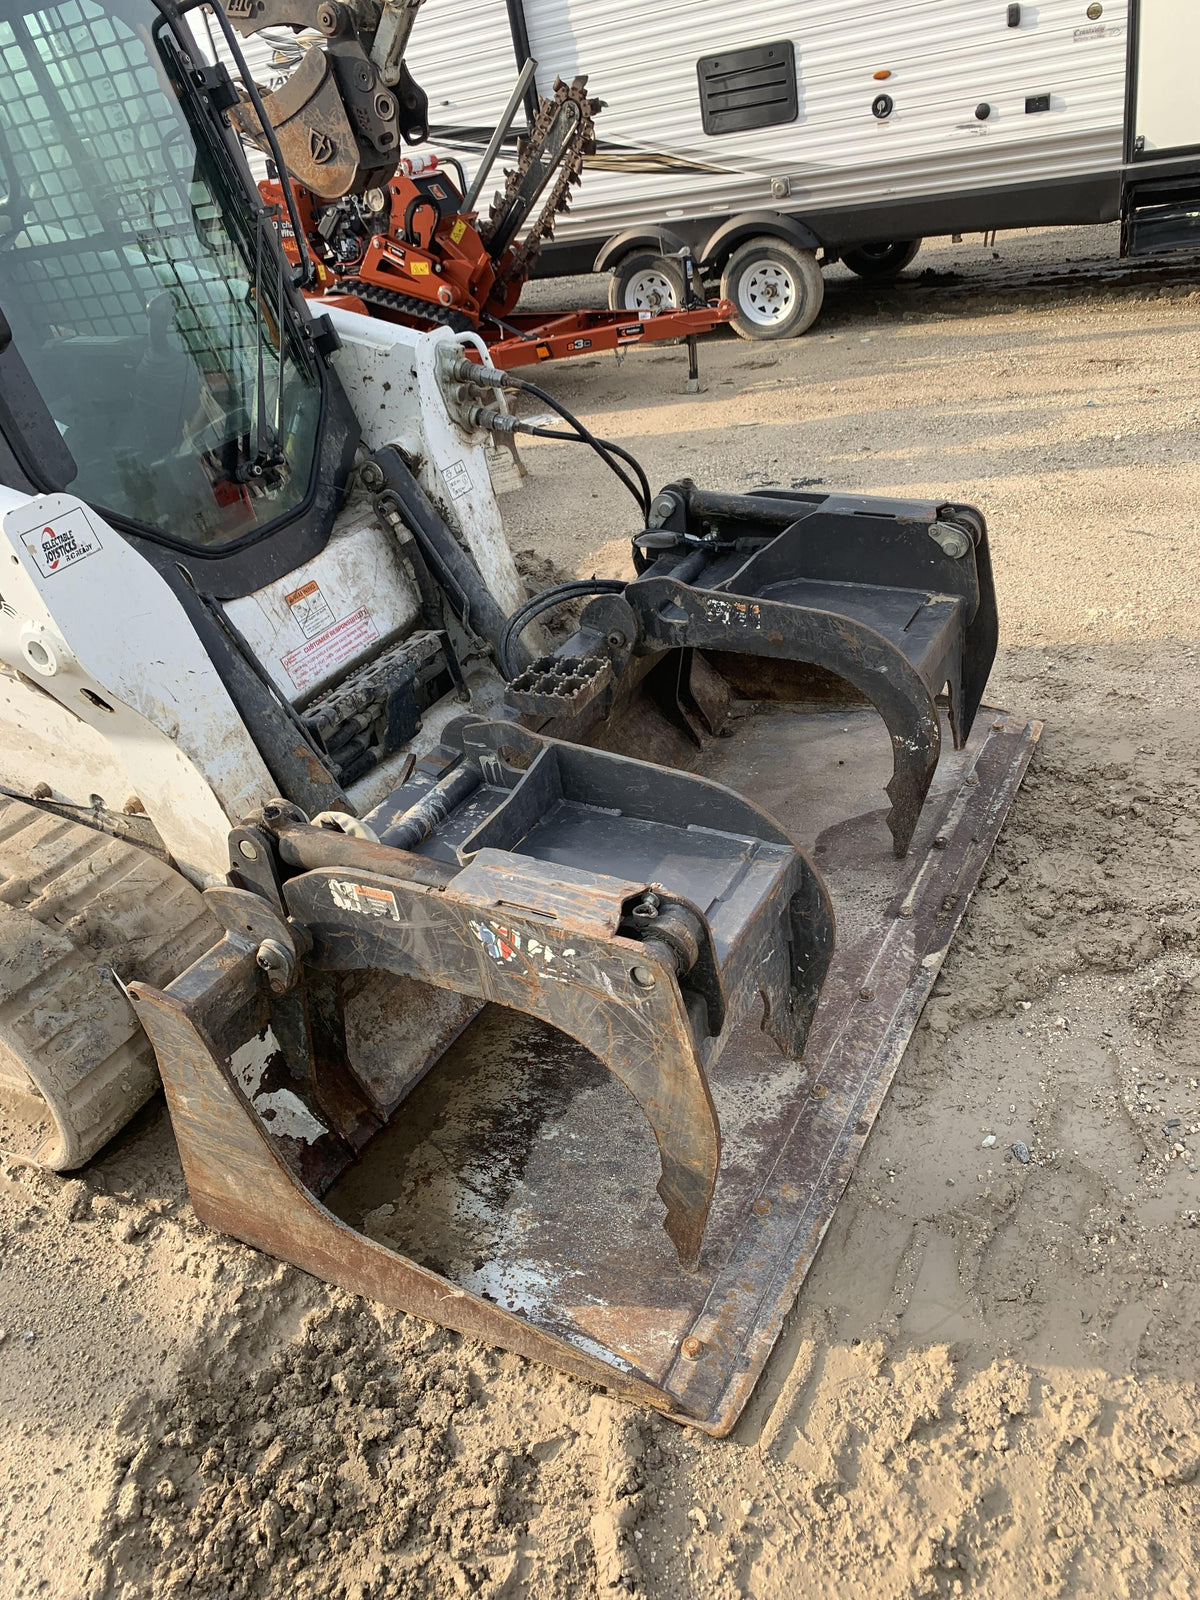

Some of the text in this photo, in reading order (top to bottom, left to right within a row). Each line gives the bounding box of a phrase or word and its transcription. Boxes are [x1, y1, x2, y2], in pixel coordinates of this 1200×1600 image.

[42, 530, 74, 552] SELECTABLE
[45, 539, 78, 564] JOYSTICKS
[304, 632, 330, 653] CUSTOMER
[330, 609, 368, 637] RESPONSIBILITY
